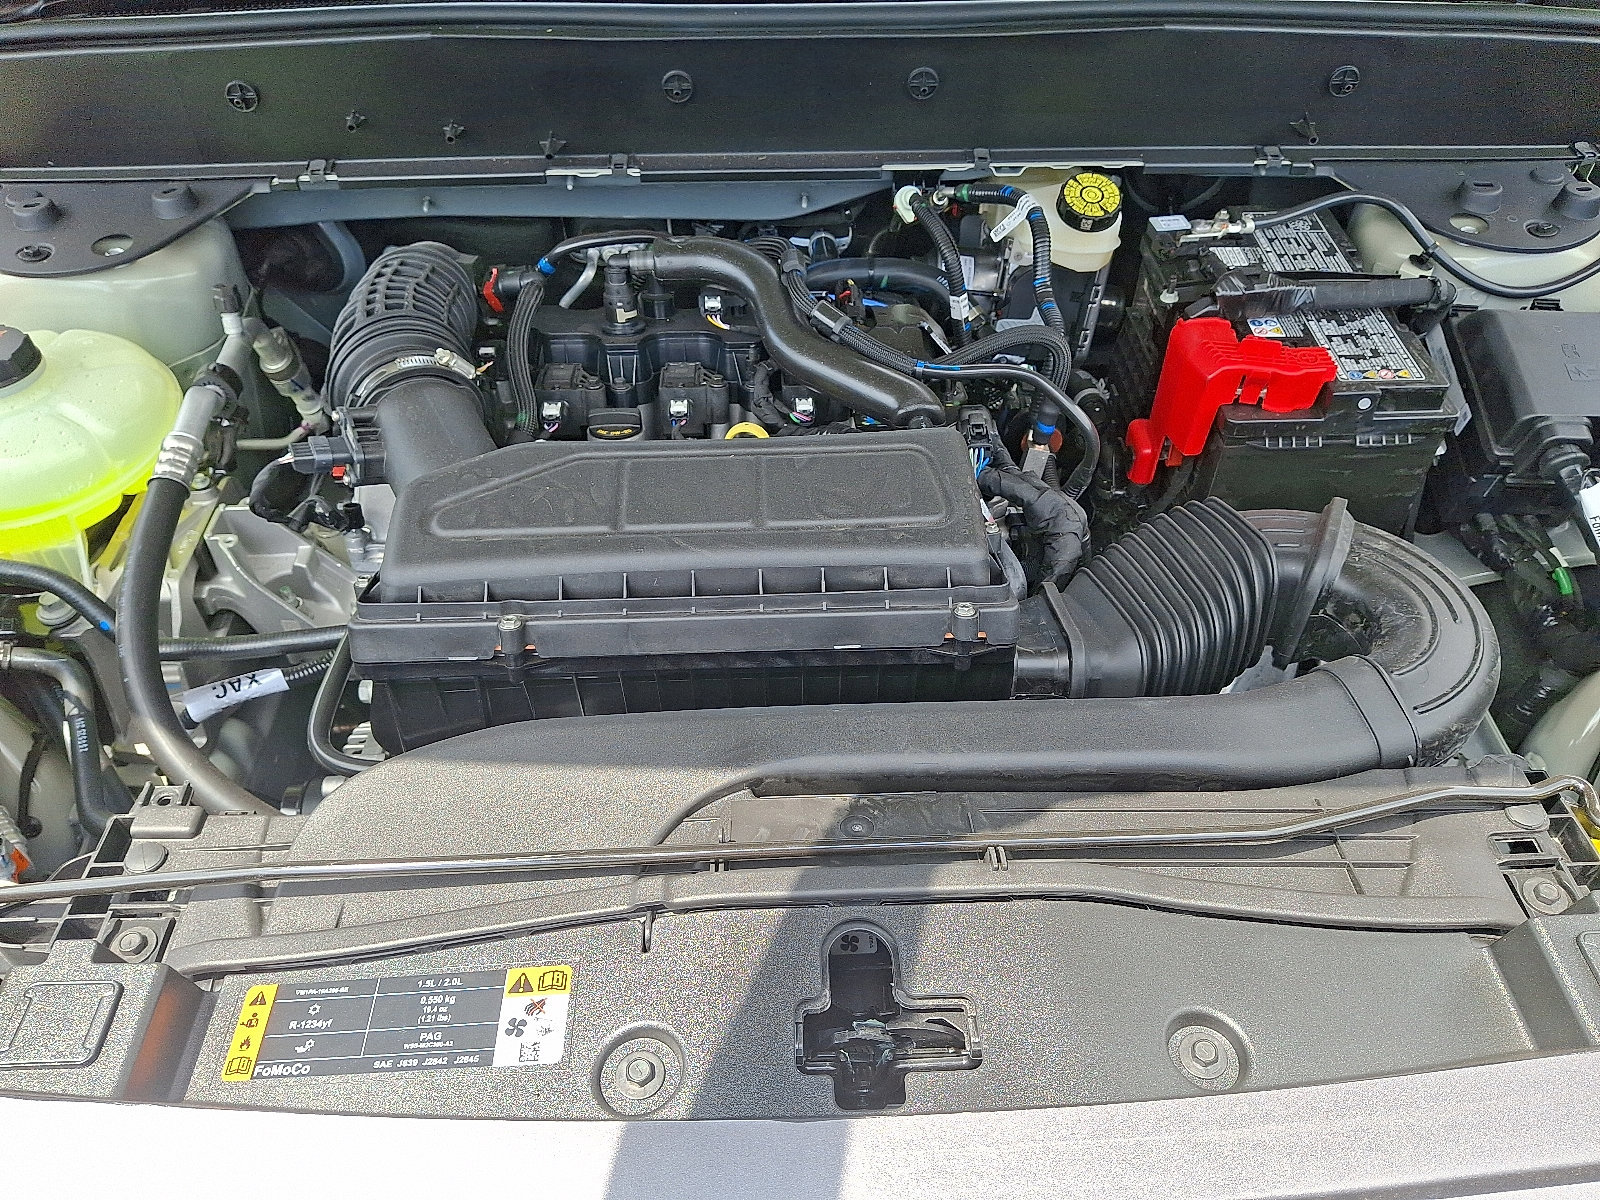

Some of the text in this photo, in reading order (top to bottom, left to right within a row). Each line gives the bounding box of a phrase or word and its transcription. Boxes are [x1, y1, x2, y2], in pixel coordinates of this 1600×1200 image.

[443, 977, 463, 987] 2.0L
[444, 994, 456, 1005] kg
[288, 1018, 333, 1030] R-1234yf
[420, 1031, 442, 1042] PAG
[253, 1063, 311, 1077] FoMoCo
[373, 1060, 393, 1069] SAE
